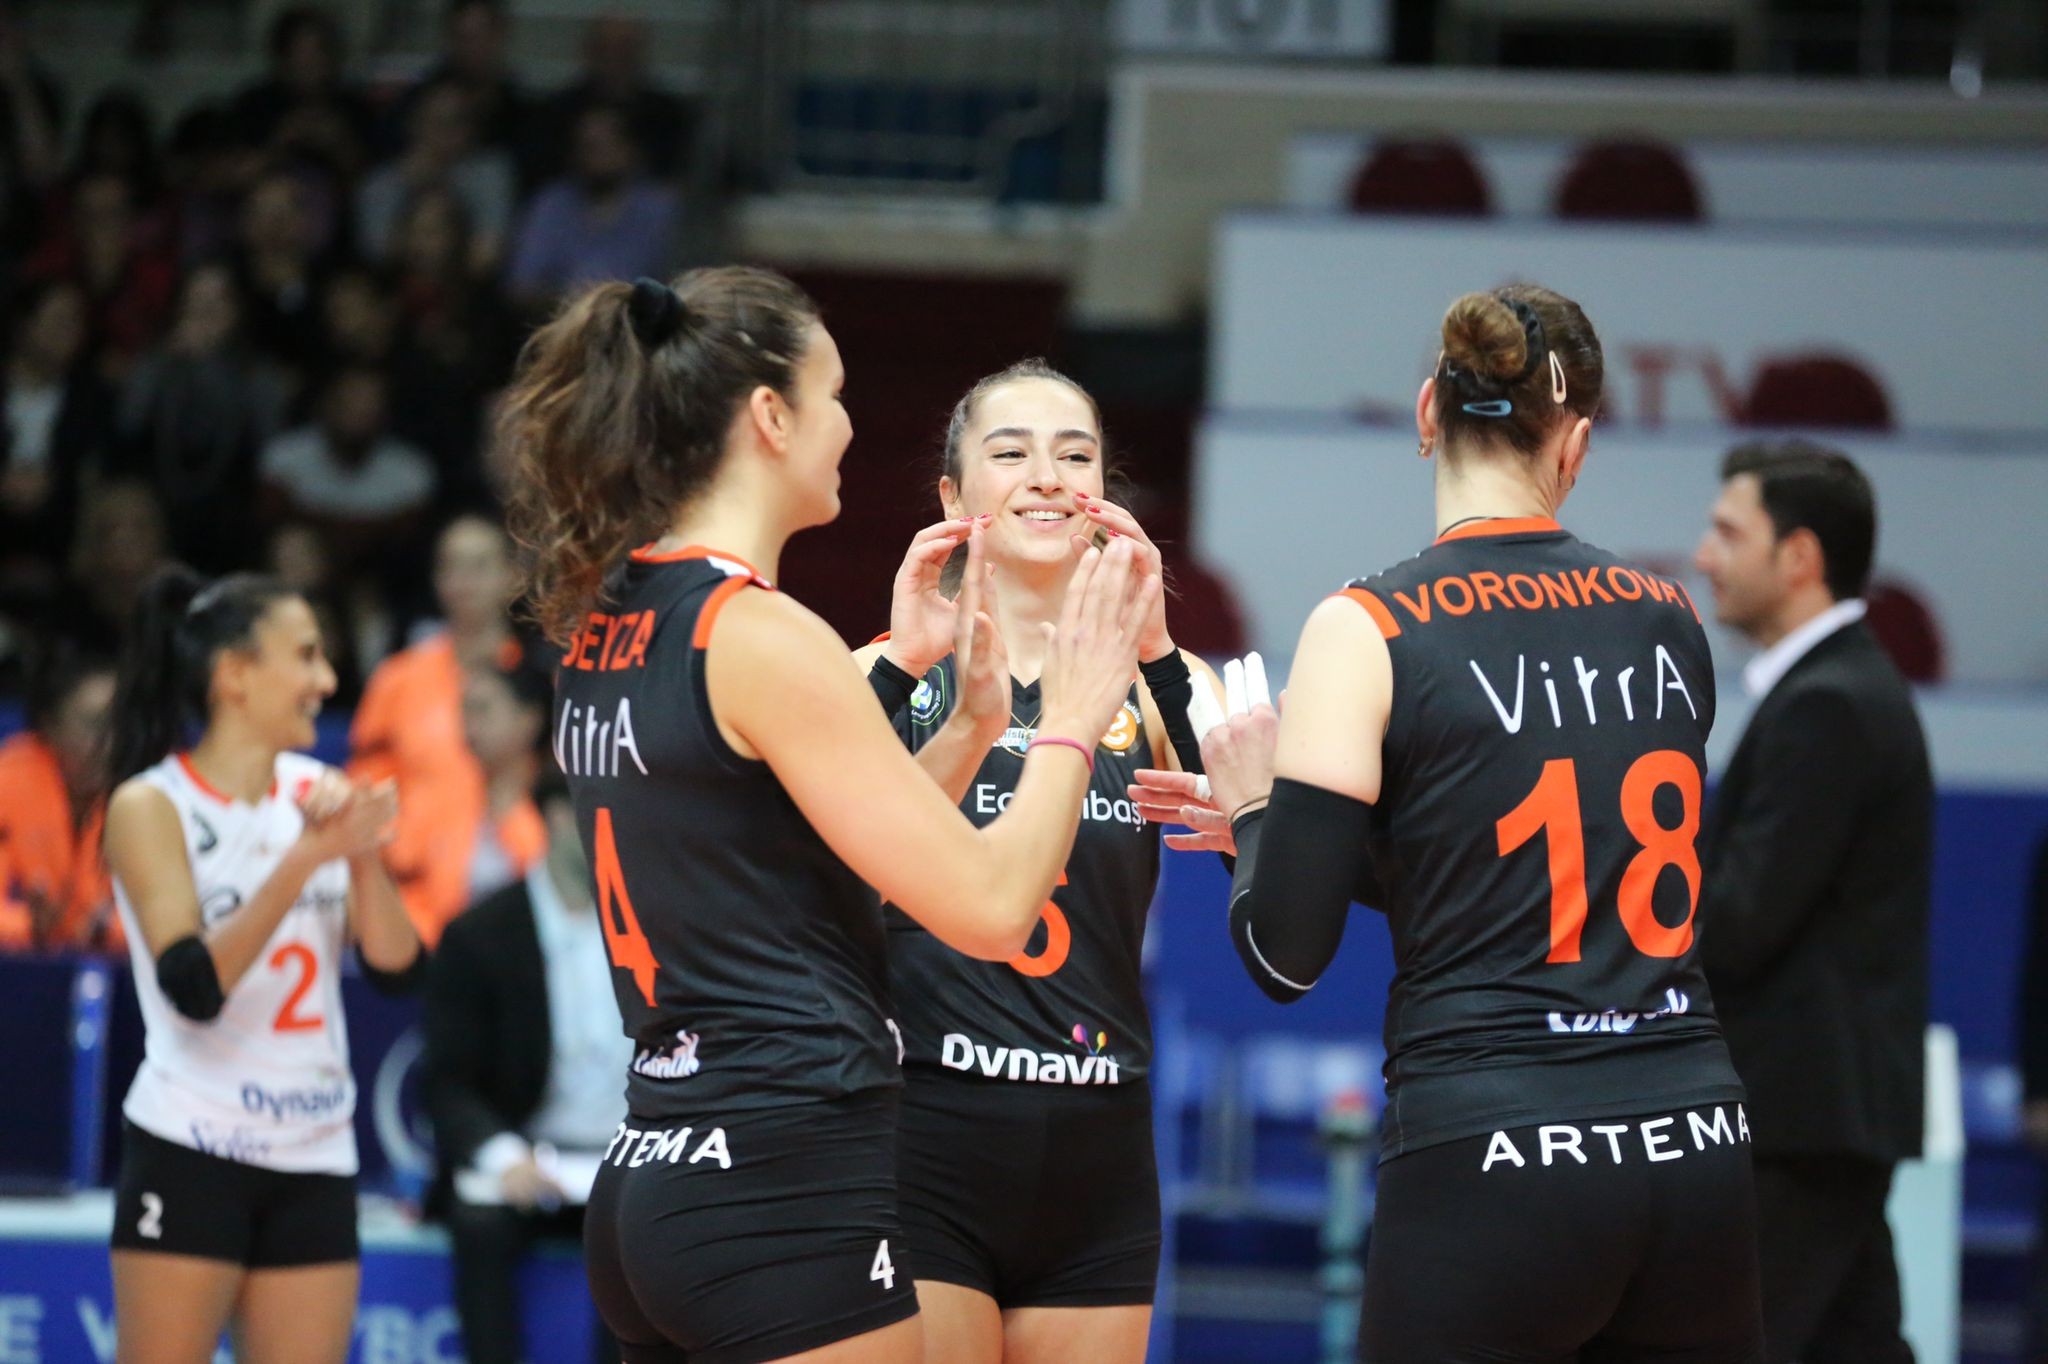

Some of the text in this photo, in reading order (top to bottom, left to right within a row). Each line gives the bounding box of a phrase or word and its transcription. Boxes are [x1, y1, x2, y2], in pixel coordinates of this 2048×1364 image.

[1469, 644, 1697, 734] VitrA
[1496, 749, 1702, 964] 18
[595, 807, 661, 1008] 4
[268, 936, 325, 1033] 2
[603, 1121, 732, 1169] RTEMA
[1481, 1102, 1752, 1173] ARTEMA
[136, 1191, 163, 1240] 2
[869, 1239, 895, 1290] 4
